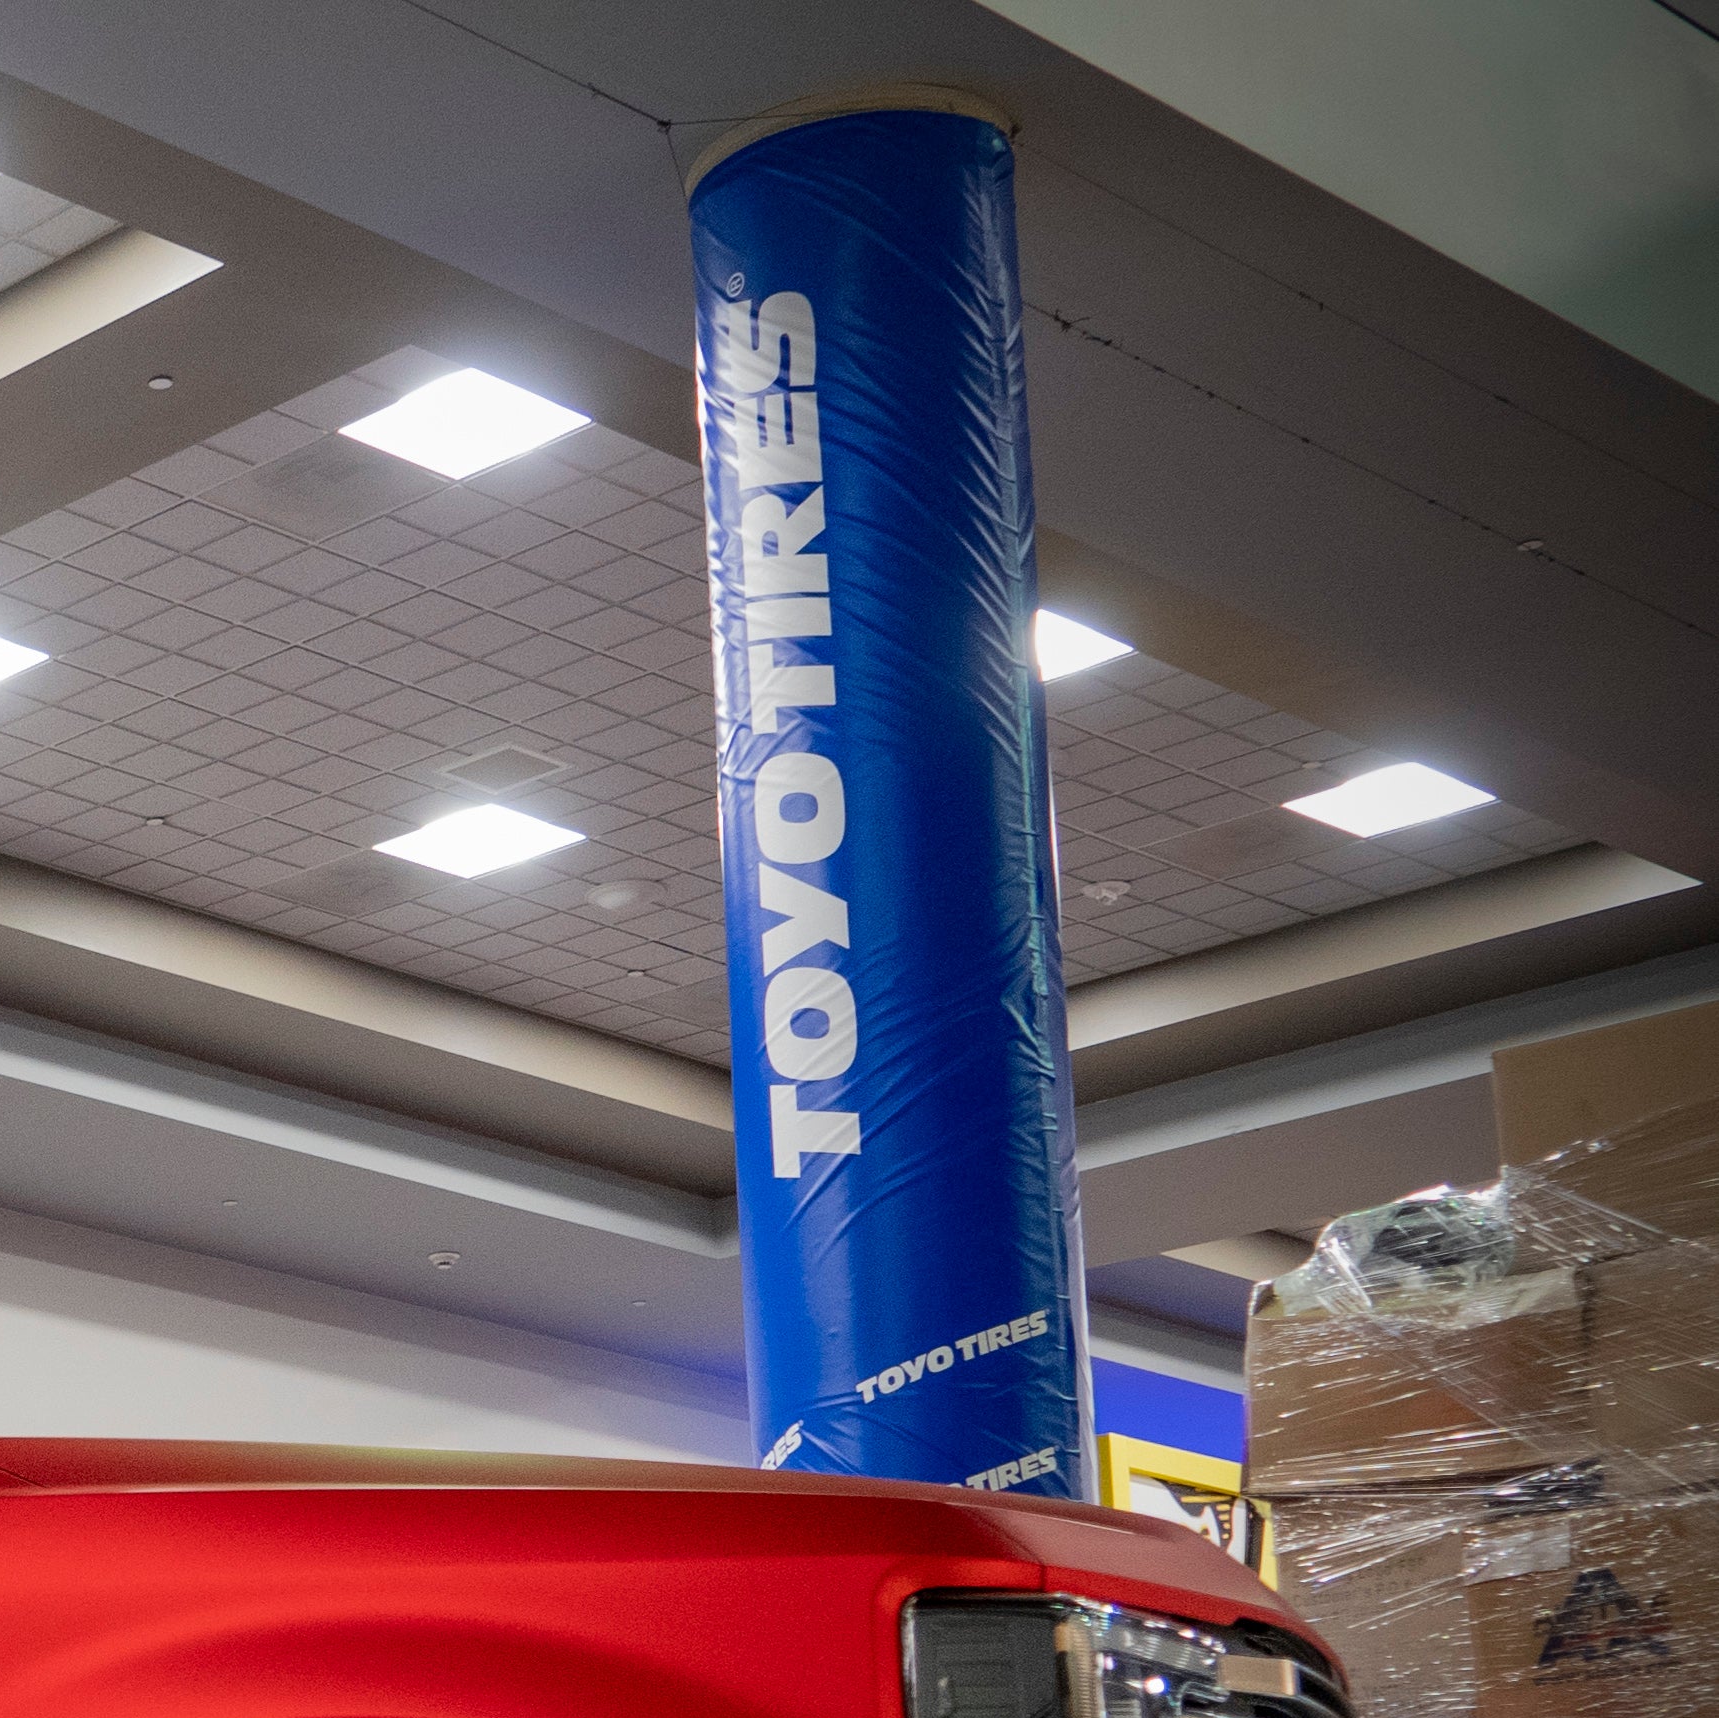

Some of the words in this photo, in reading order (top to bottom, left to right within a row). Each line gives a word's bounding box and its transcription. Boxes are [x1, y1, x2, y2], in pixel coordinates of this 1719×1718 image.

[755, 752, 862, 1179] TOYO
[855, 1345, 954, 1405] TOYO
[955, 1310, 1048, 1364] TIRES
[965, 1446, 1058, 1494] TIRES
